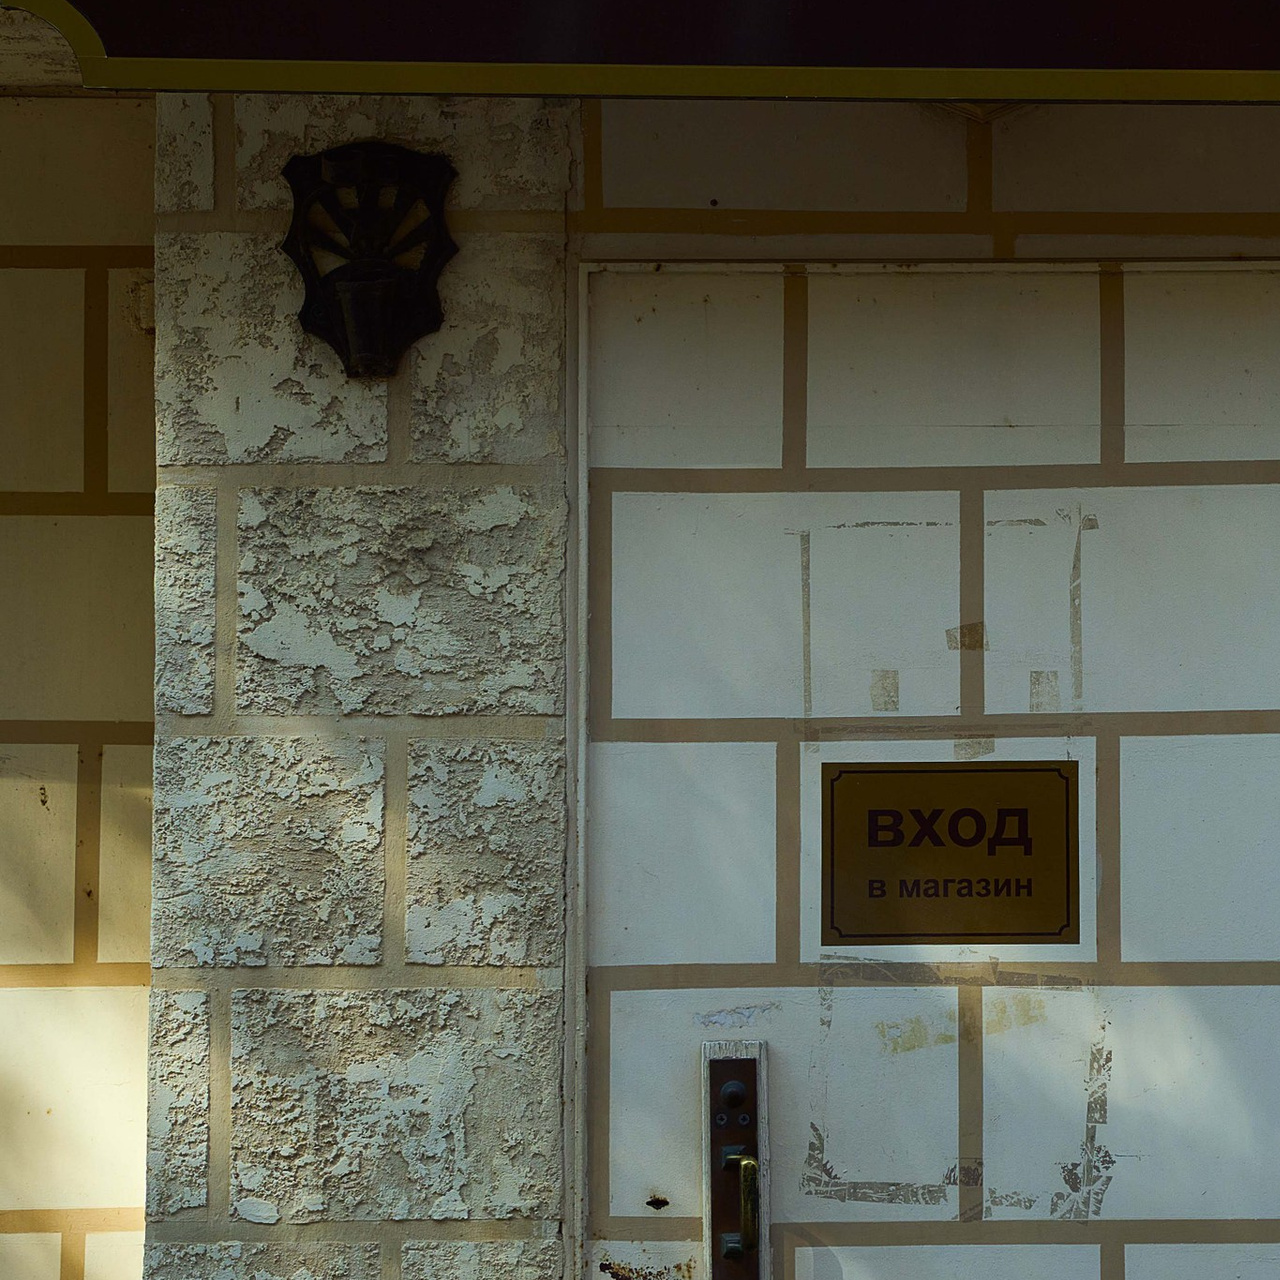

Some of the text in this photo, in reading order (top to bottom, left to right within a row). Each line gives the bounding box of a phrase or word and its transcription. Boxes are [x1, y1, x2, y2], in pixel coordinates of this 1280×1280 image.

[866, 807, 1033, 857] ВХОД
[867, 876, 1034, 899] в магазин
